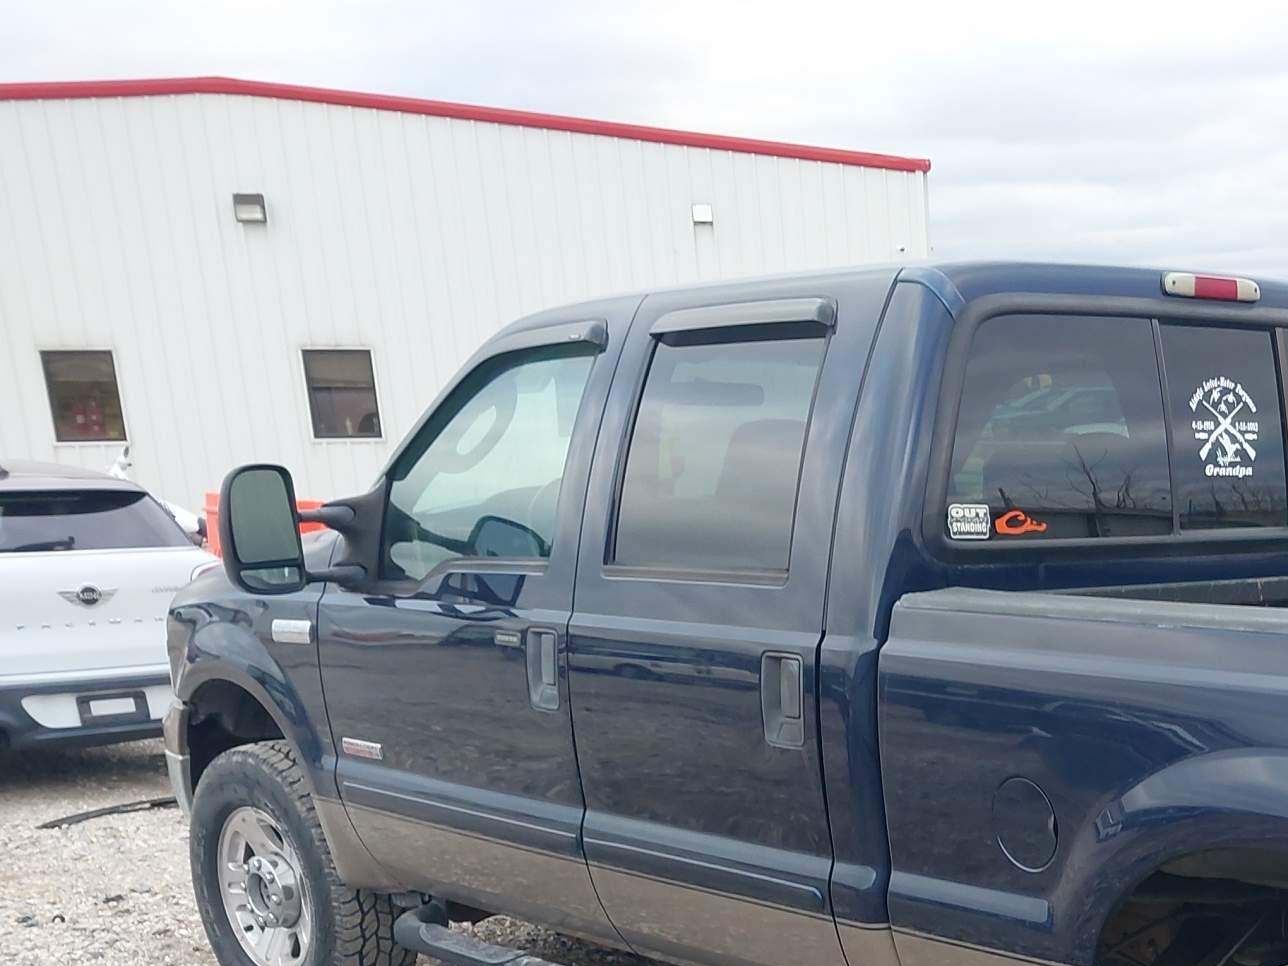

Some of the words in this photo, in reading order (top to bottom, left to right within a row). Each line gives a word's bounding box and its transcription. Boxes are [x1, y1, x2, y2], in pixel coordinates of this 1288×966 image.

[1205, 464, 1253, 478] Grandpa
[951, 508, 986, 518] OUT
[953, 522, 986, 532] STANDING
